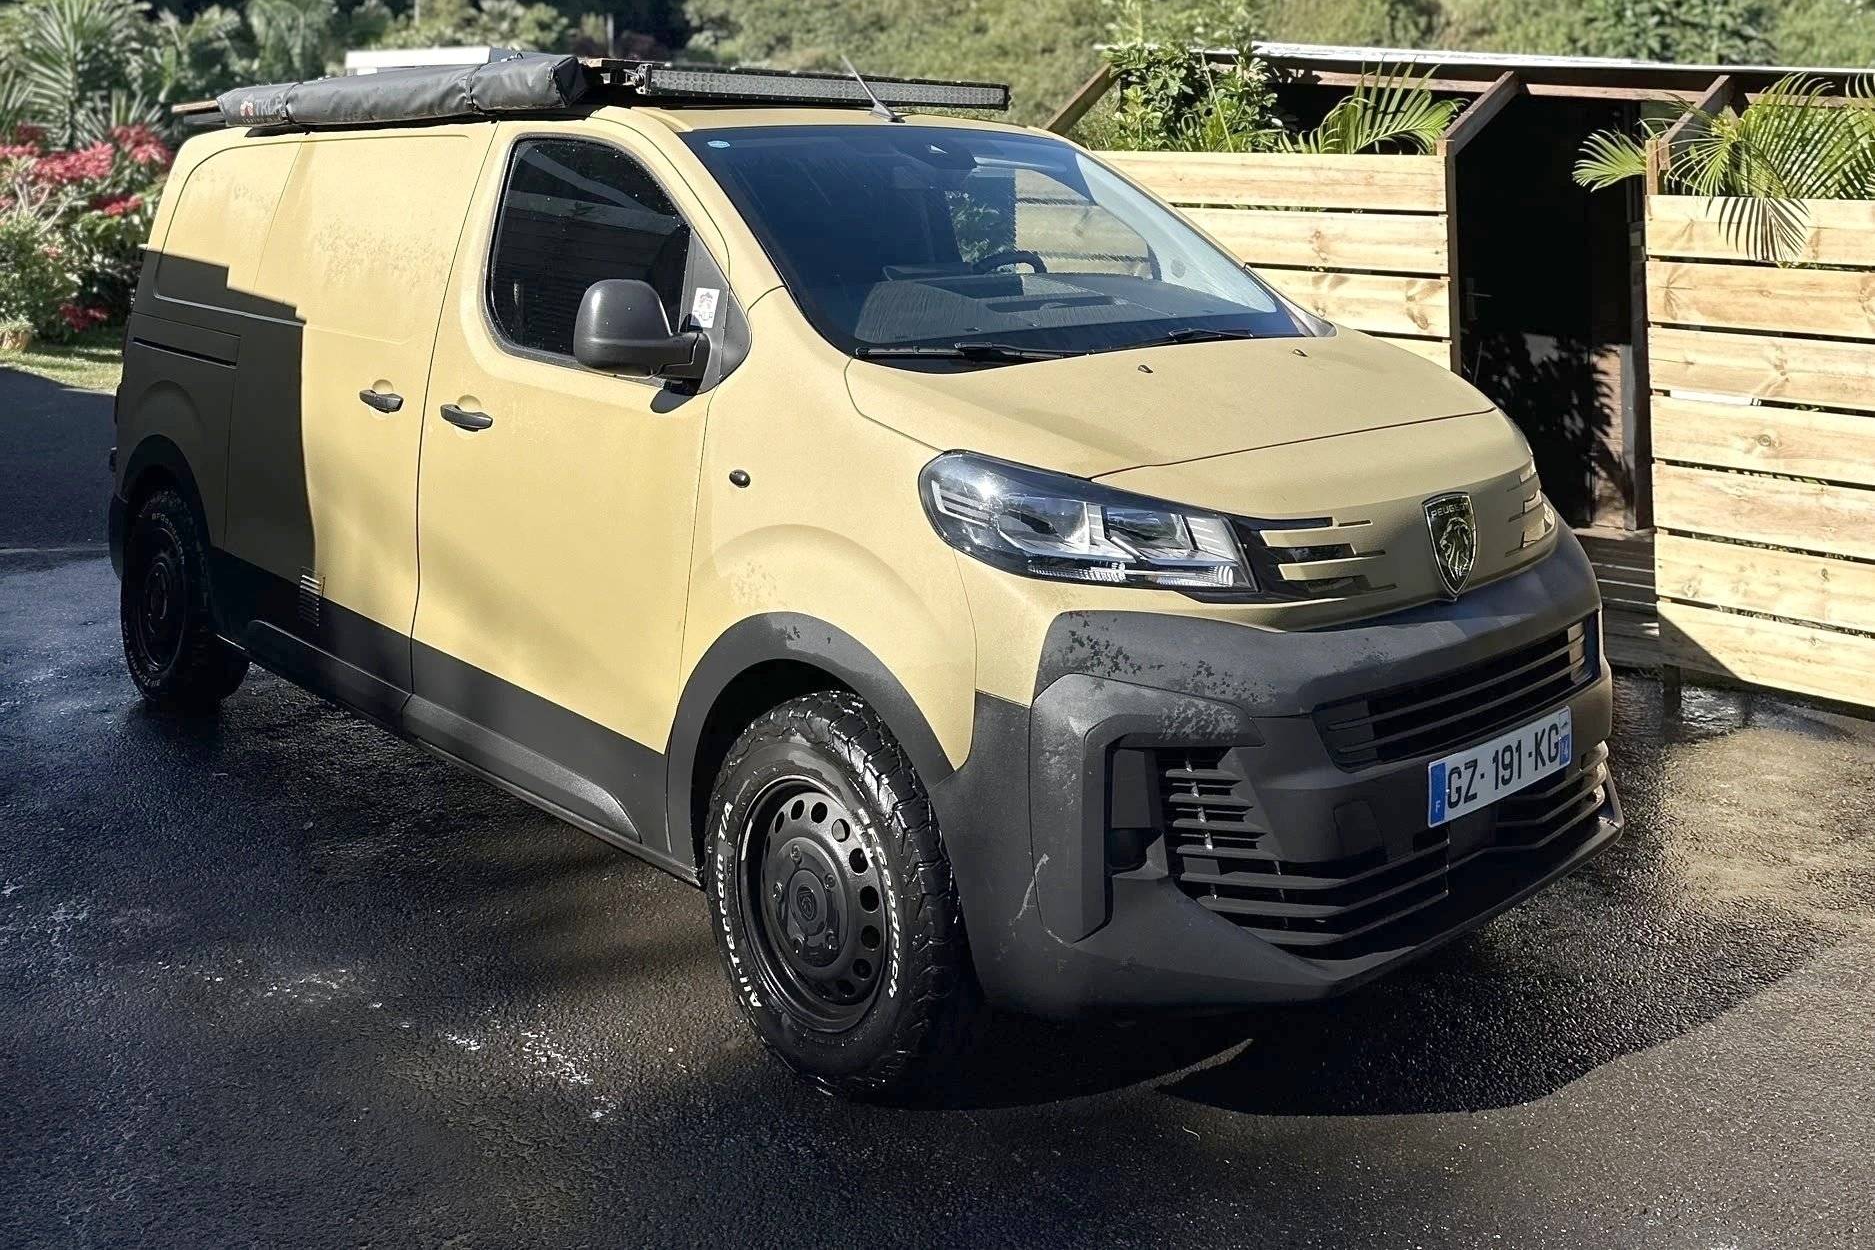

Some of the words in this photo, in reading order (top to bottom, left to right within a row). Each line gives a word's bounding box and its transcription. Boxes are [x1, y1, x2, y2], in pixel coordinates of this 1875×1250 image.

[717, 801, 734, 842] T/A
[1434, 800, 1441, 813] F
[716, 853, 762, 1007] All-Terrain
[857, 807, 900, 998] BFGoodrich
